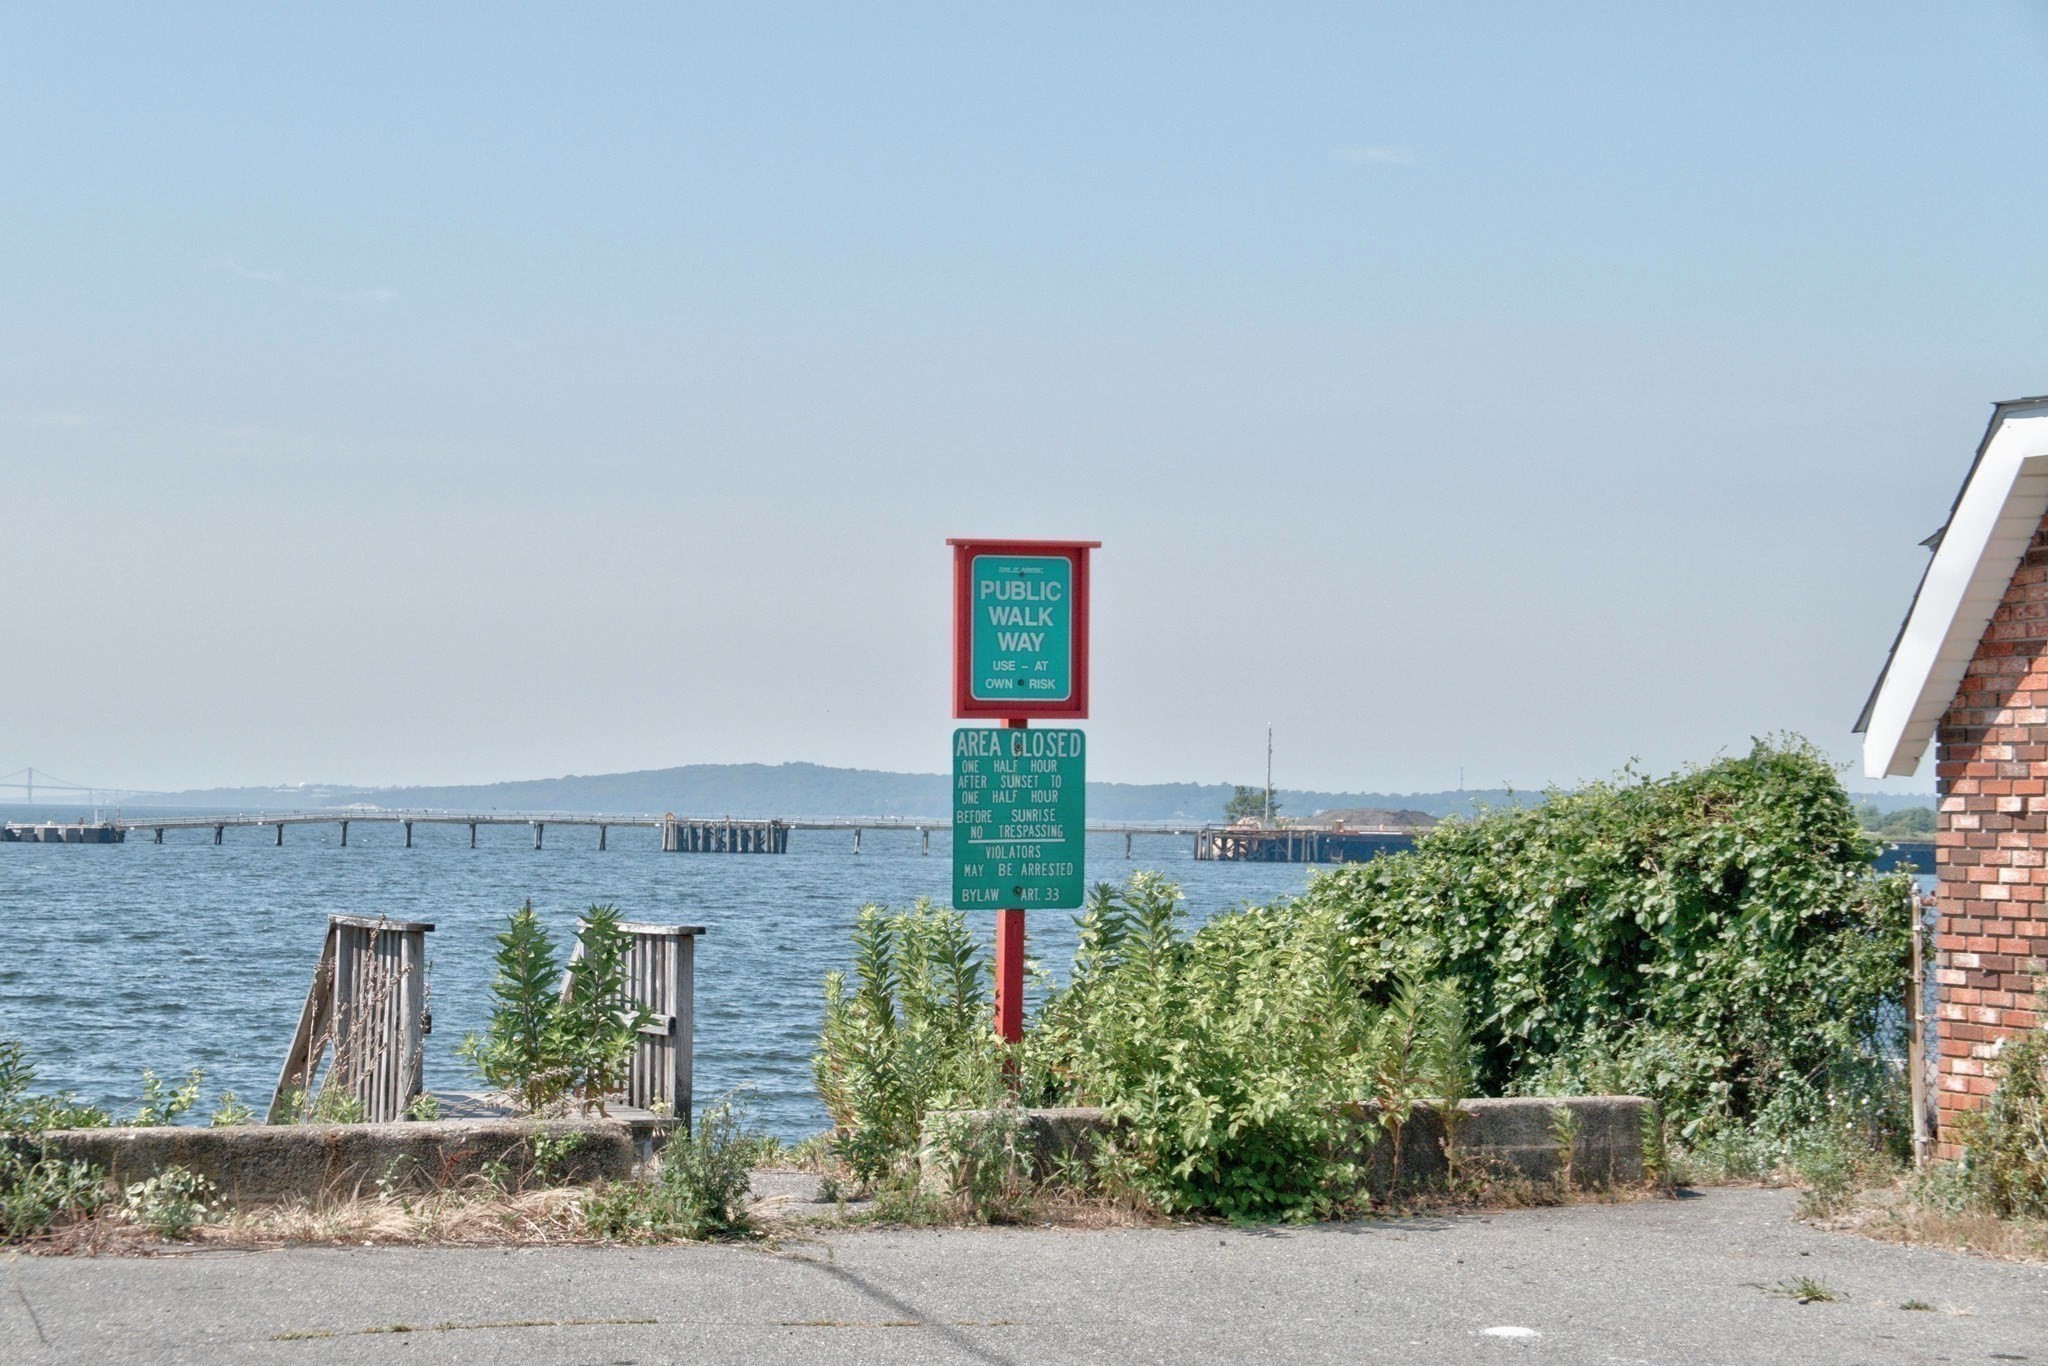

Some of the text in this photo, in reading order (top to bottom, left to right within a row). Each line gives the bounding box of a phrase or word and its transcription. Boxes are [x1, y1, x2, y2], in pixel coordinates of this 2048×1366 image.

[980, 580, 1062, 601] PUBLIC
[988, 606, 1054, 627] WALK
[997, 632, 1045, 652] WAY
[992, 660, 1016, 671] USE
[1034, 660, 1049, 671] AT
[985, 678, 1056, 690] OWN RISK
[956, 731, 1081, 758] AREA CLOSED
[962, 759, 1057, 774] ONE HALF HOUR
[957, 774, 1062, 789] AFTER SUNSET TO
[961, 789, 1059, 805] ONE HALF HOUR
[956, 808, 1056, 824] BEFORE SUNRISE
[970, 824, 1064, 839] NO TRESPASSING
[985, 845, 1042, 860] VIOLATORS
[963, 862, 1074, 877] MAY BE ARRESTED
[961, 887, 1060, 902] BYLAW ART. 33
